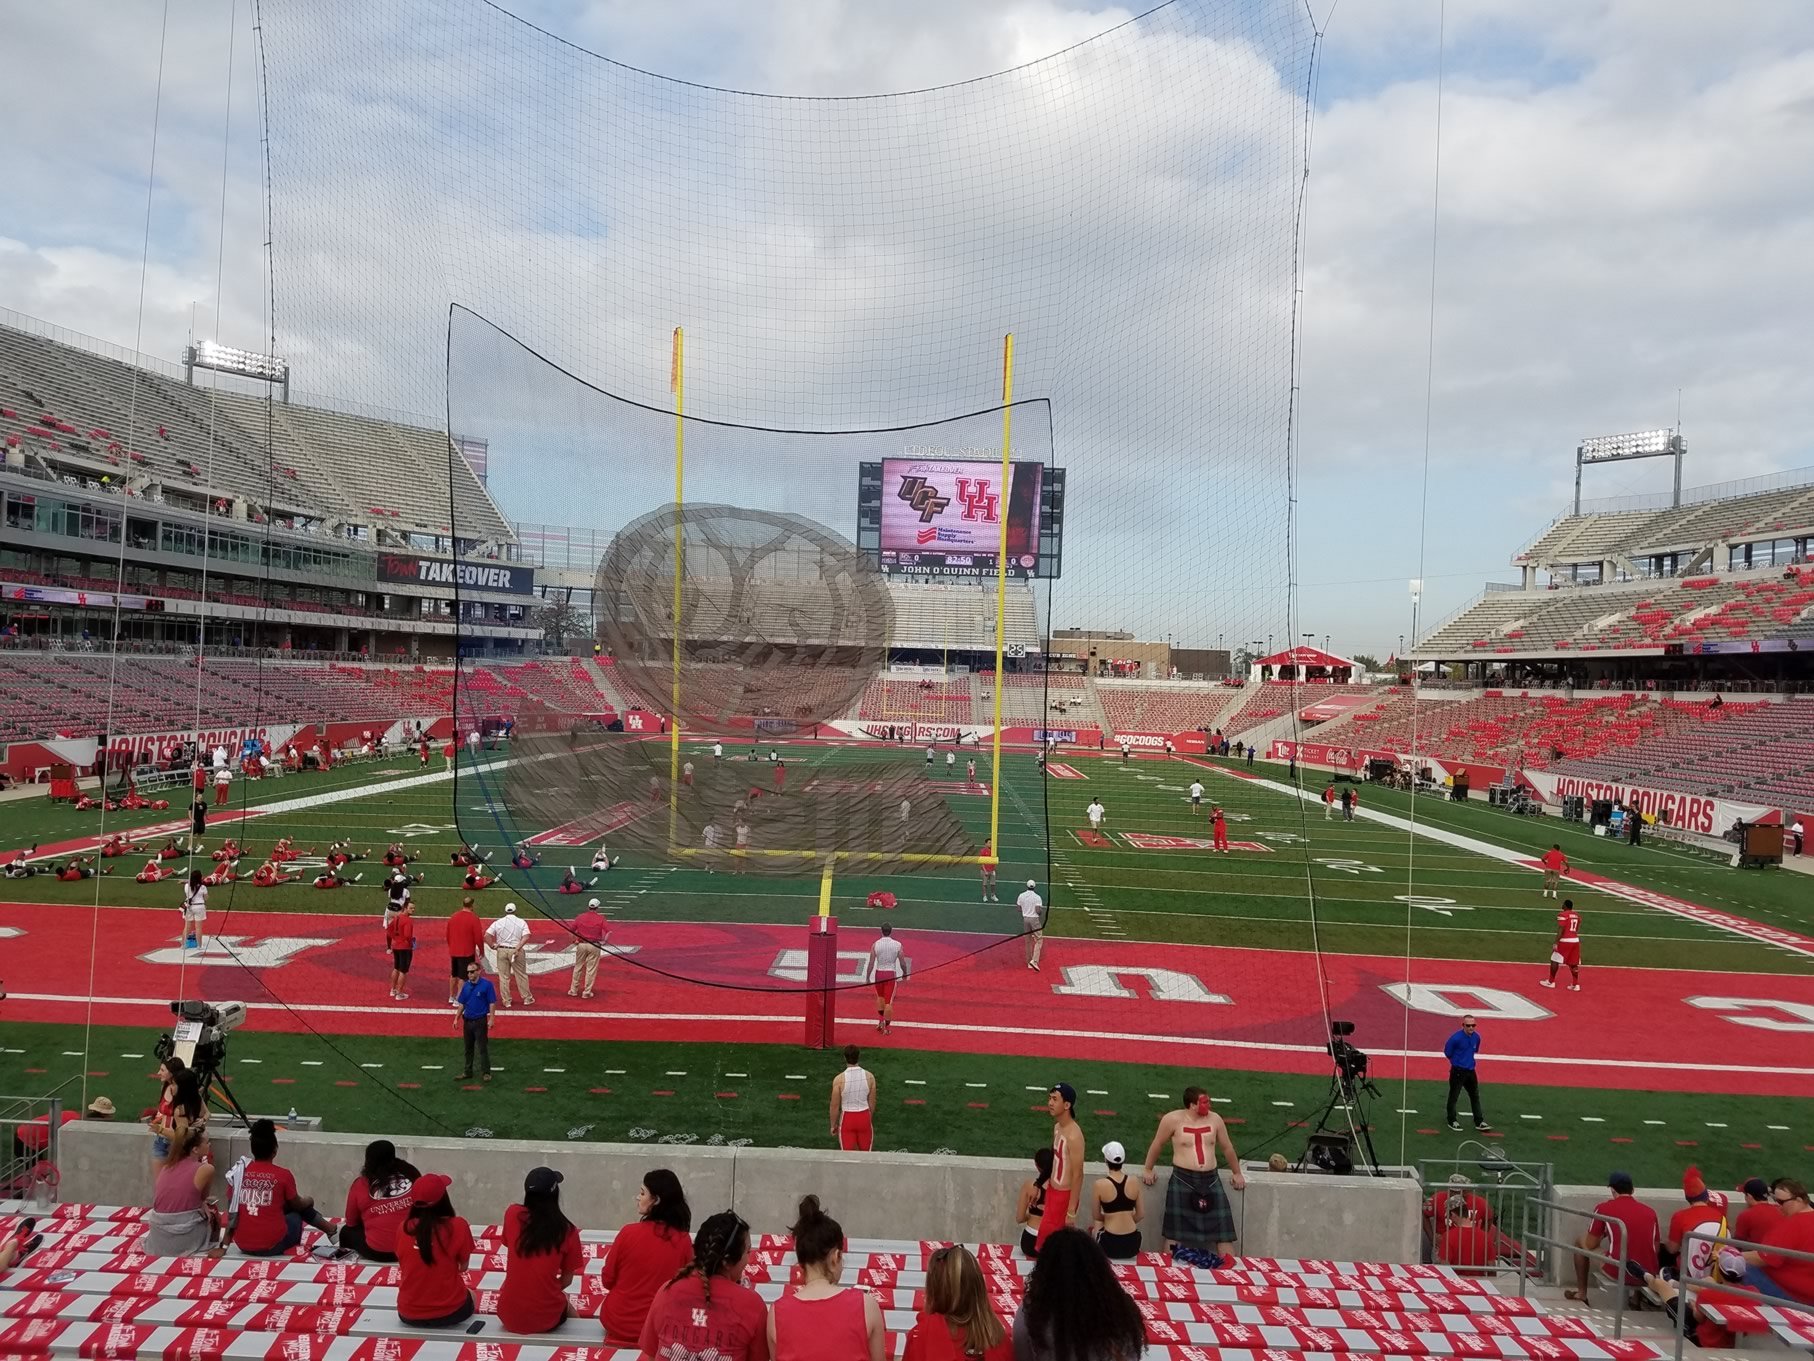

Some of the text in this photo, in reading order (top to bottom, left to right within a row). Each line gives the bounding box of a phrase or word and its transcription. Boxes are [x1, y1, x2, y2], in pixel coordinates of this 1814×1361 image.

[898, 475, 951, 523] UCF
[955, 477, 999, 523] UH
[419, 560, 511, 588] TAKEOVER
[901, 566, 1015, 577] JOHN O'QUINN FIED
[1010, 645, 1024, 656] 25
[629, 715, 642, 729] UH
[1114, 734, 1164, 746] #GOCOOGS
[1630, 788, 1715, 833] COUGARS
[1183, 1125, 1212, 1166] T
[240, 1189, 273, 1206] OUSE!
[370, 1196, 413, 1213] UNIVERSIT
[692, 1308, 708, 1328] UH
